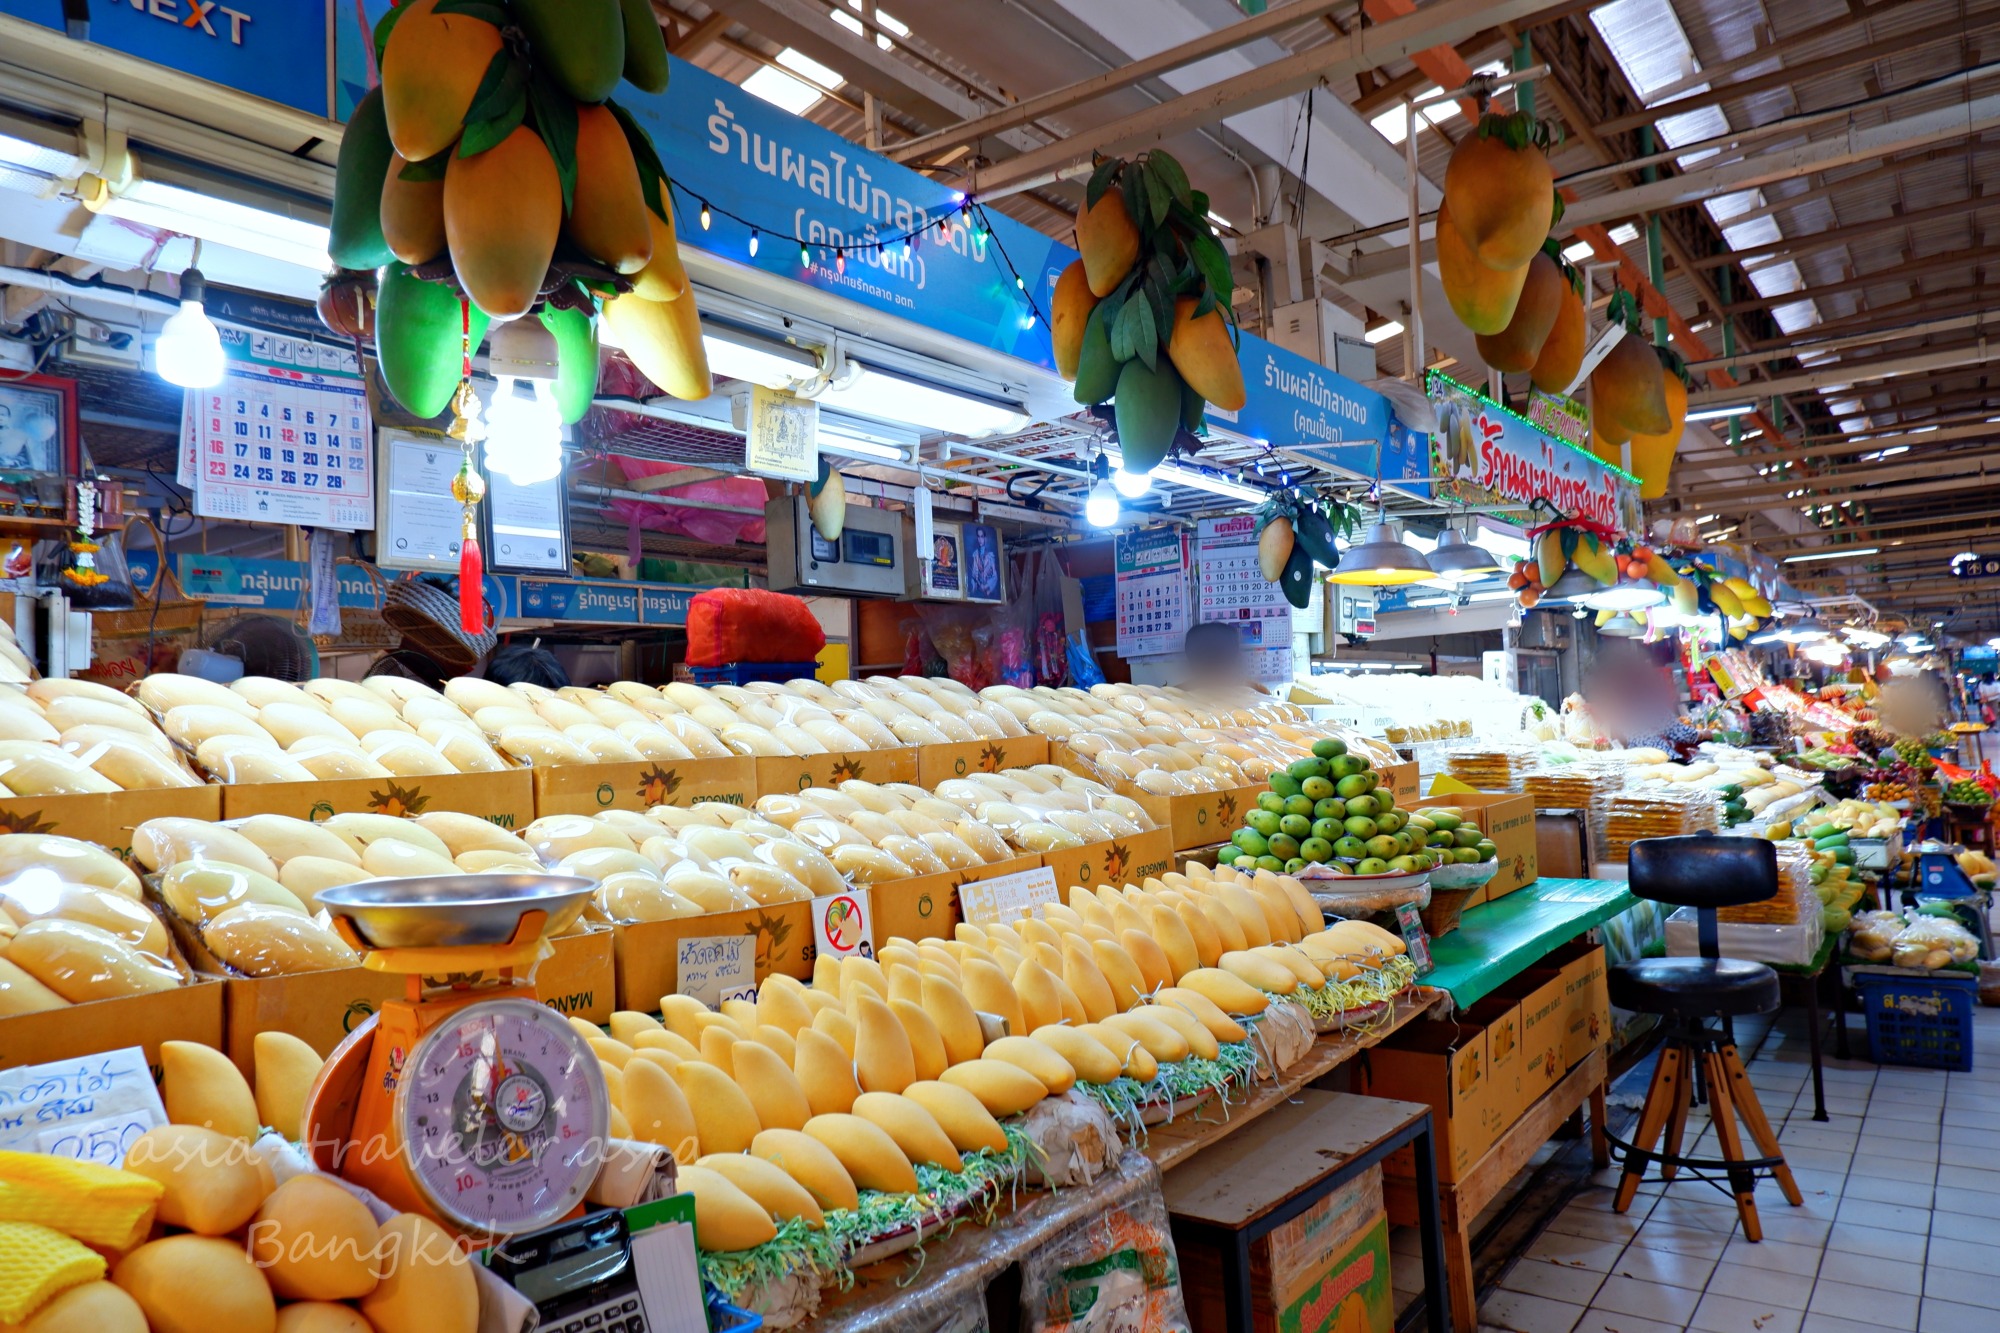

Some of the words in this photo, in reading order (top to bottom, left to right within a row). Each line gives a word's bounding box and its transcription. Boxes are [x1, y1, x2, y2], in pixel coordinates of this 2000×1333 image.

[112, 0, 251, 45] EXT
[708, 98, 986, 263] ร้านผลไม้กลางดง
[1264, 355, 1367, 426] ร้านผลไม้กลางดง
[212, 396, 222, 410] 2
[237, 400, 246, 414] 3
[261, 404, 268, 418] 4
[284, 408, 292, 422] 5
[306, 412, 314, 424] 6
[330, 414, 337, 427] 7
[352, 417, 360, 430] 8
[1294, 409, 1342, 444] (คุณเปี๊ยก)
[1529, 397, 1585, 443] 081-2790074
[212, 418, 220, 432] 9
[234, 422, 248, 436] 10
[258, 425, 271, 439] 11
[281, 428, 294, 442] 12
[304, 432, 316, 446] 13
[327, 434, 340, 448] 14
[350, 437, 362, 450] 15
[210, 440, 224, 454] 16
[234, 443, 248, 457] 17
[258, 446, 272, 460] 18
[282, 450, 294, 463] 19
[303, 452, 318, 466] 20
[327, 455, 341, 468] 21
[349, 458, 364, 470] 22
[210, 461, 226, 476] 23
[234, 464, 250, 479] 24
[258, 468, 273, 482] 25
[281, 470, 296, 484] 26
[304, 473, 319, 486] 27
[327, 476, 342, 488] 28
[1205, 562, 1210, 570] 2
[1229, 560, 1234, 568] 4
[1254, 558, 1258, 566] 6
[1205, 574, 1210, 582] 9
[1228, 572, 1236, 580] 11
[1252, 570, 1262, 578] 13
[1204, 586, 1213, 594] 16
[1228, 584, 1237, 592] 18
[1252, 582, 1262, 590] 20
[1264, 582, 1274, 590] 21
[1203, 598, 1213, 606] 23
[1216, 597, 1225, 605] 24
[1227, 596, 1237, 604] 25
[1252, 595, 1262, 603] 27
[1264, 594, 1275, 602] 28
[692, 792, 744, 806] MANGOES
[1136, 860, 1168, 877] MANGOES
[966, 885, 994, 910] 4-5
[458, 1042, 474, 1058] 15
[541, 1046, 548, 1056] 2
[434, 1067, 446, 1076] 14
[560, 1066, 566, 1076] 3
[426, 1093, 440, 1104] 13
[426, 1126, 439, 1138] 12
[562, 1125, 572, 1138] 5
[456, 1174, 474, 1194] 10
[544, 1178, 550, 1188] 7
[487, 1194, 494, 1204] 9
[517, 1192, 524, 1202] 8
[513, 1250, 538, 1263] CASIO
